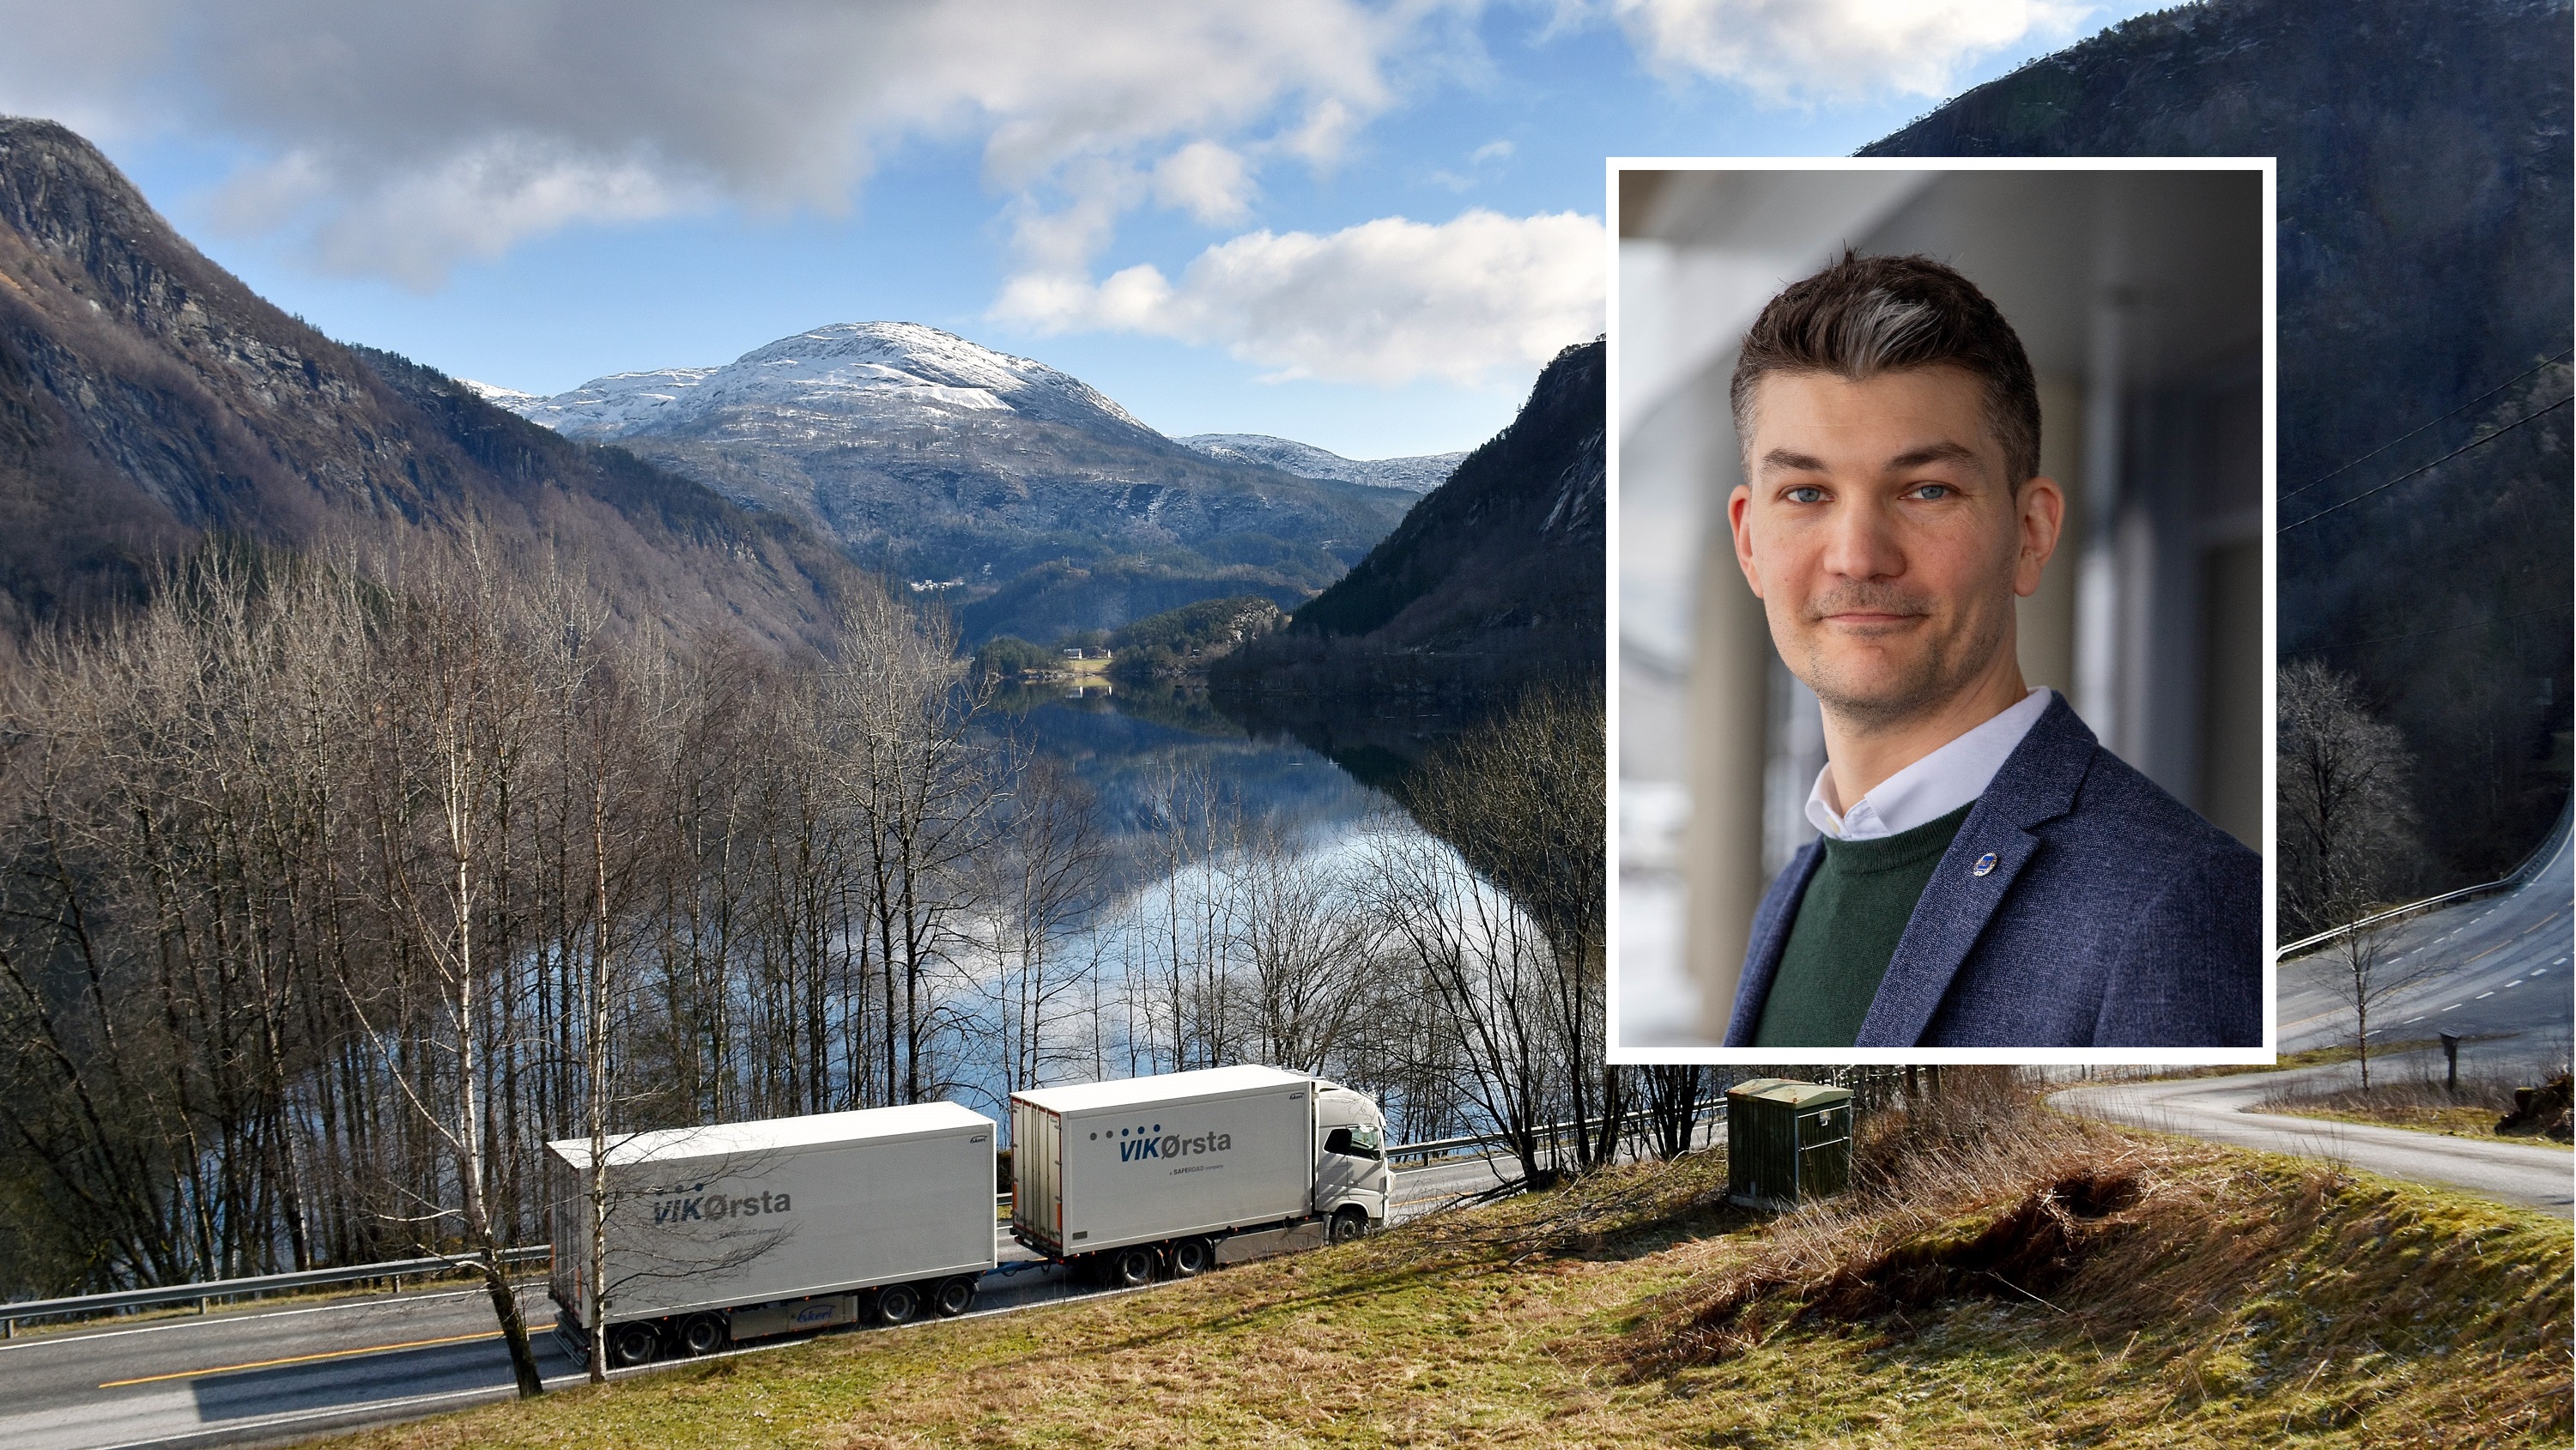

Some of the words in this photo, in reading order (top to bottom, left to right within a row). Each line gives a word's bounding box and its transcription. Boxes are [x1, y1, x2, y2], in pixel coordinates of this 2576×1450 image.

[1120, 1131, 1231, 1162] VIKØrsta
[1173, 1166, 1203, 1175] SAFEROAD
[654, 1191, 791, 1224] VIKØrsta
